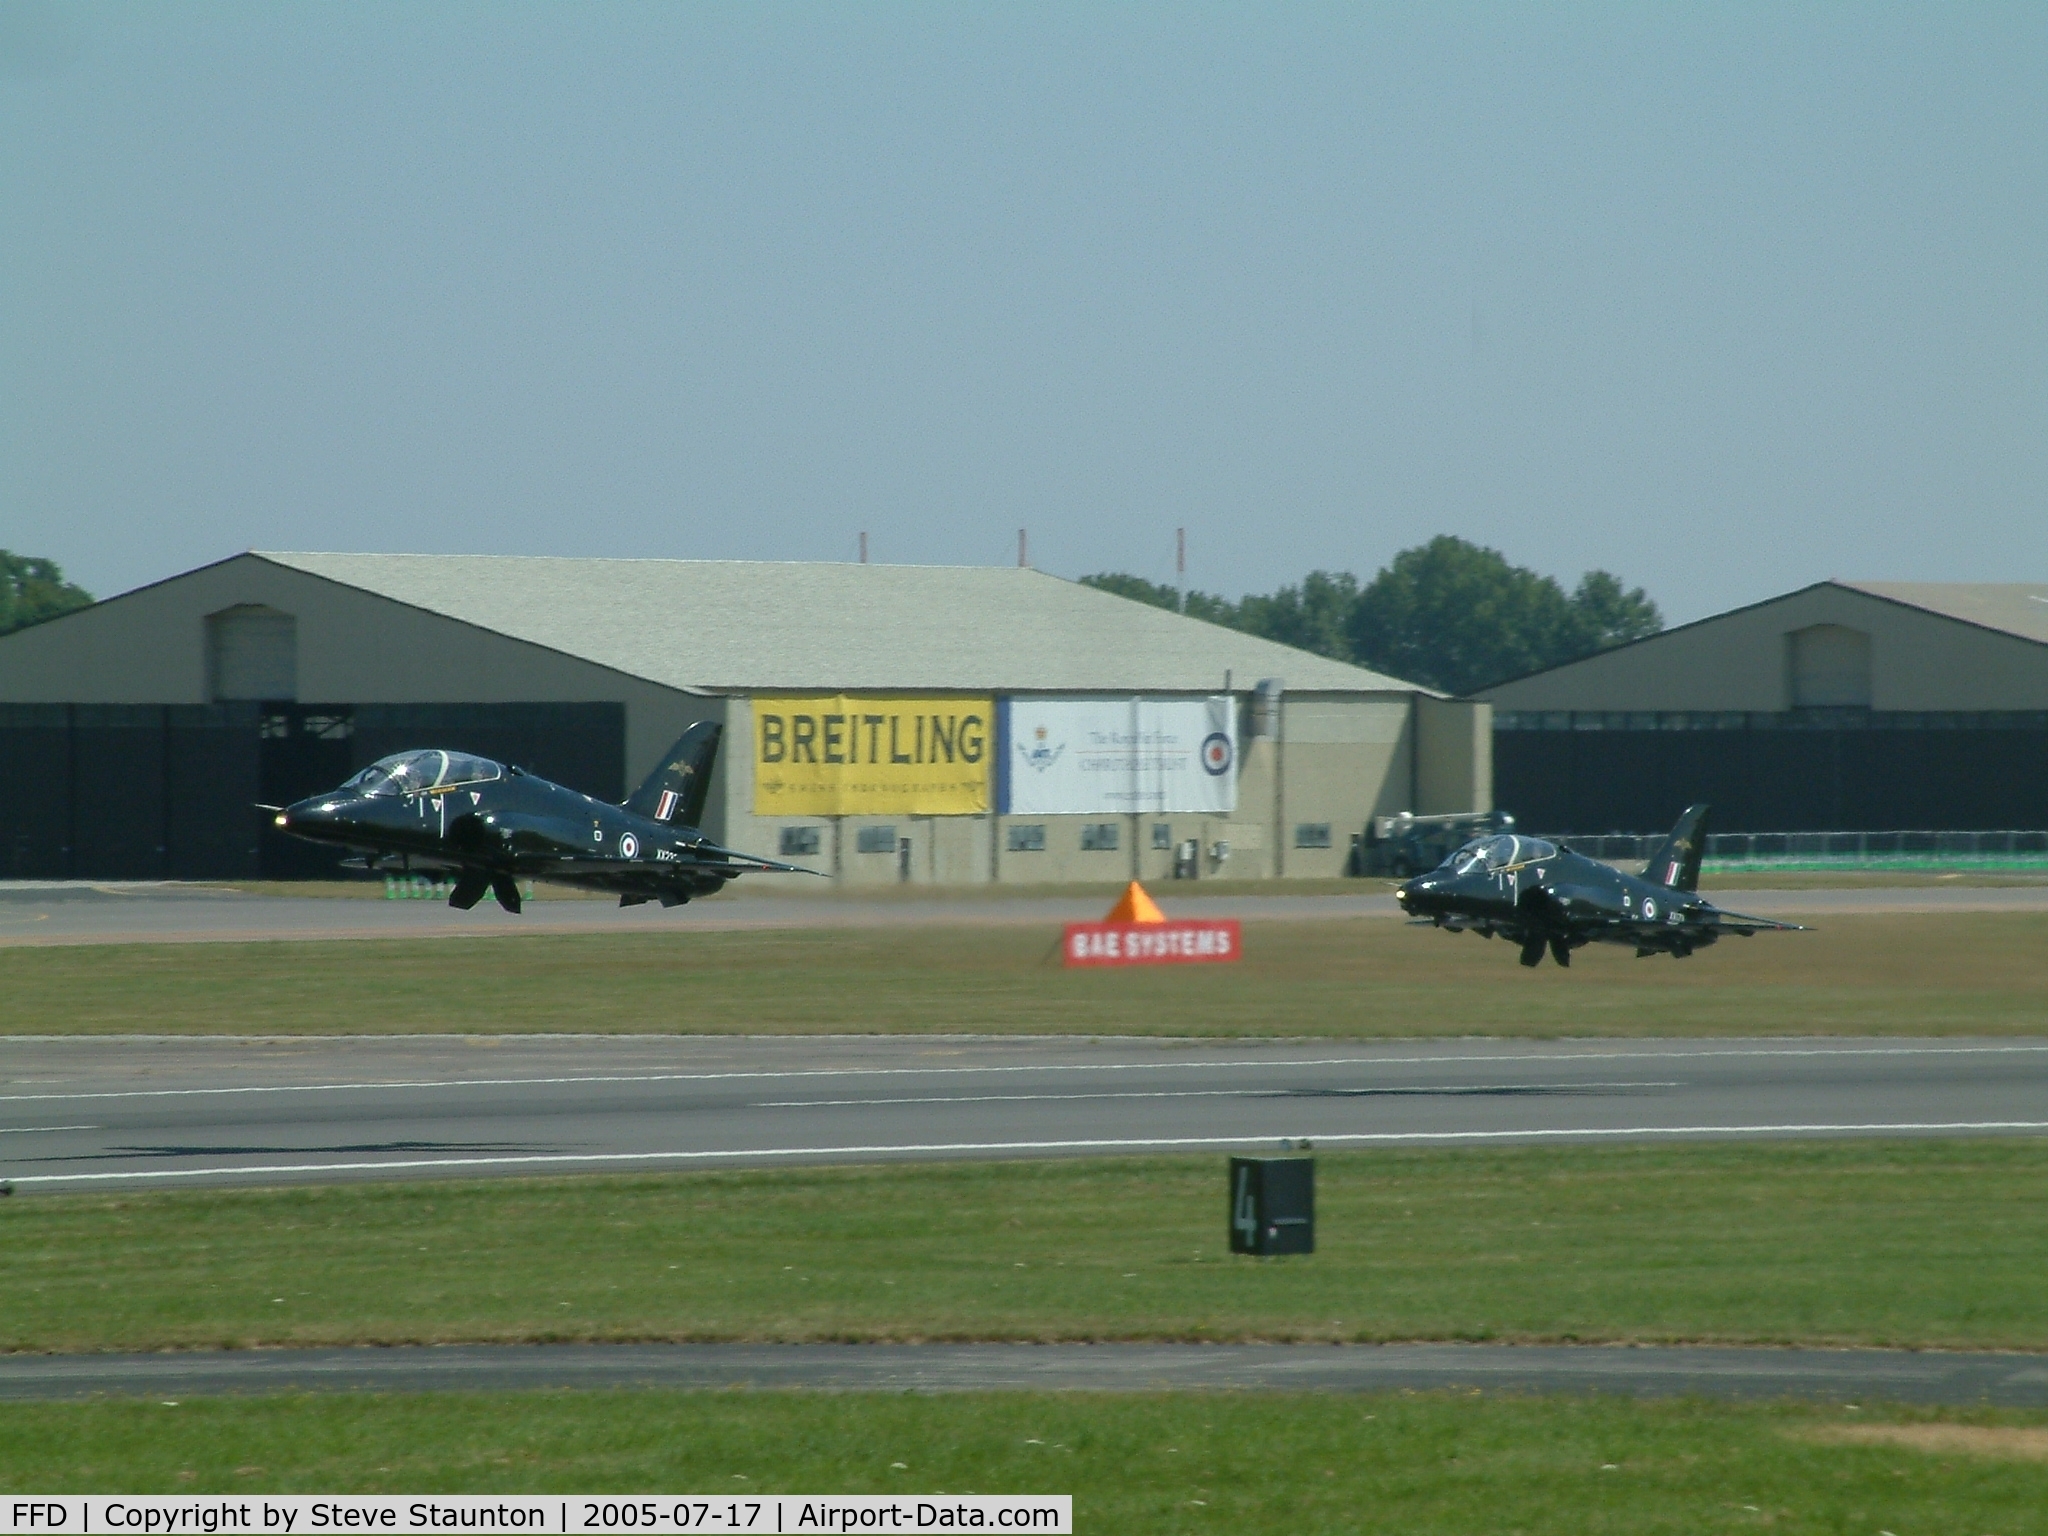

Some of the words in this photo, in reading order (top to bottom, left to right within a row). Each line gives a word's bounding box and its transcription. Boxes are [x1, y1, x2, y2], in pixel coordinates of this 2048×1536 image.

[762, 714, 983, 763] BREITLING
[1073, 932, 1120, 958] BAE
[1125, 930, 1231, 956] SYSTEMS
[1235, 1166, 1257, 1247] 4
